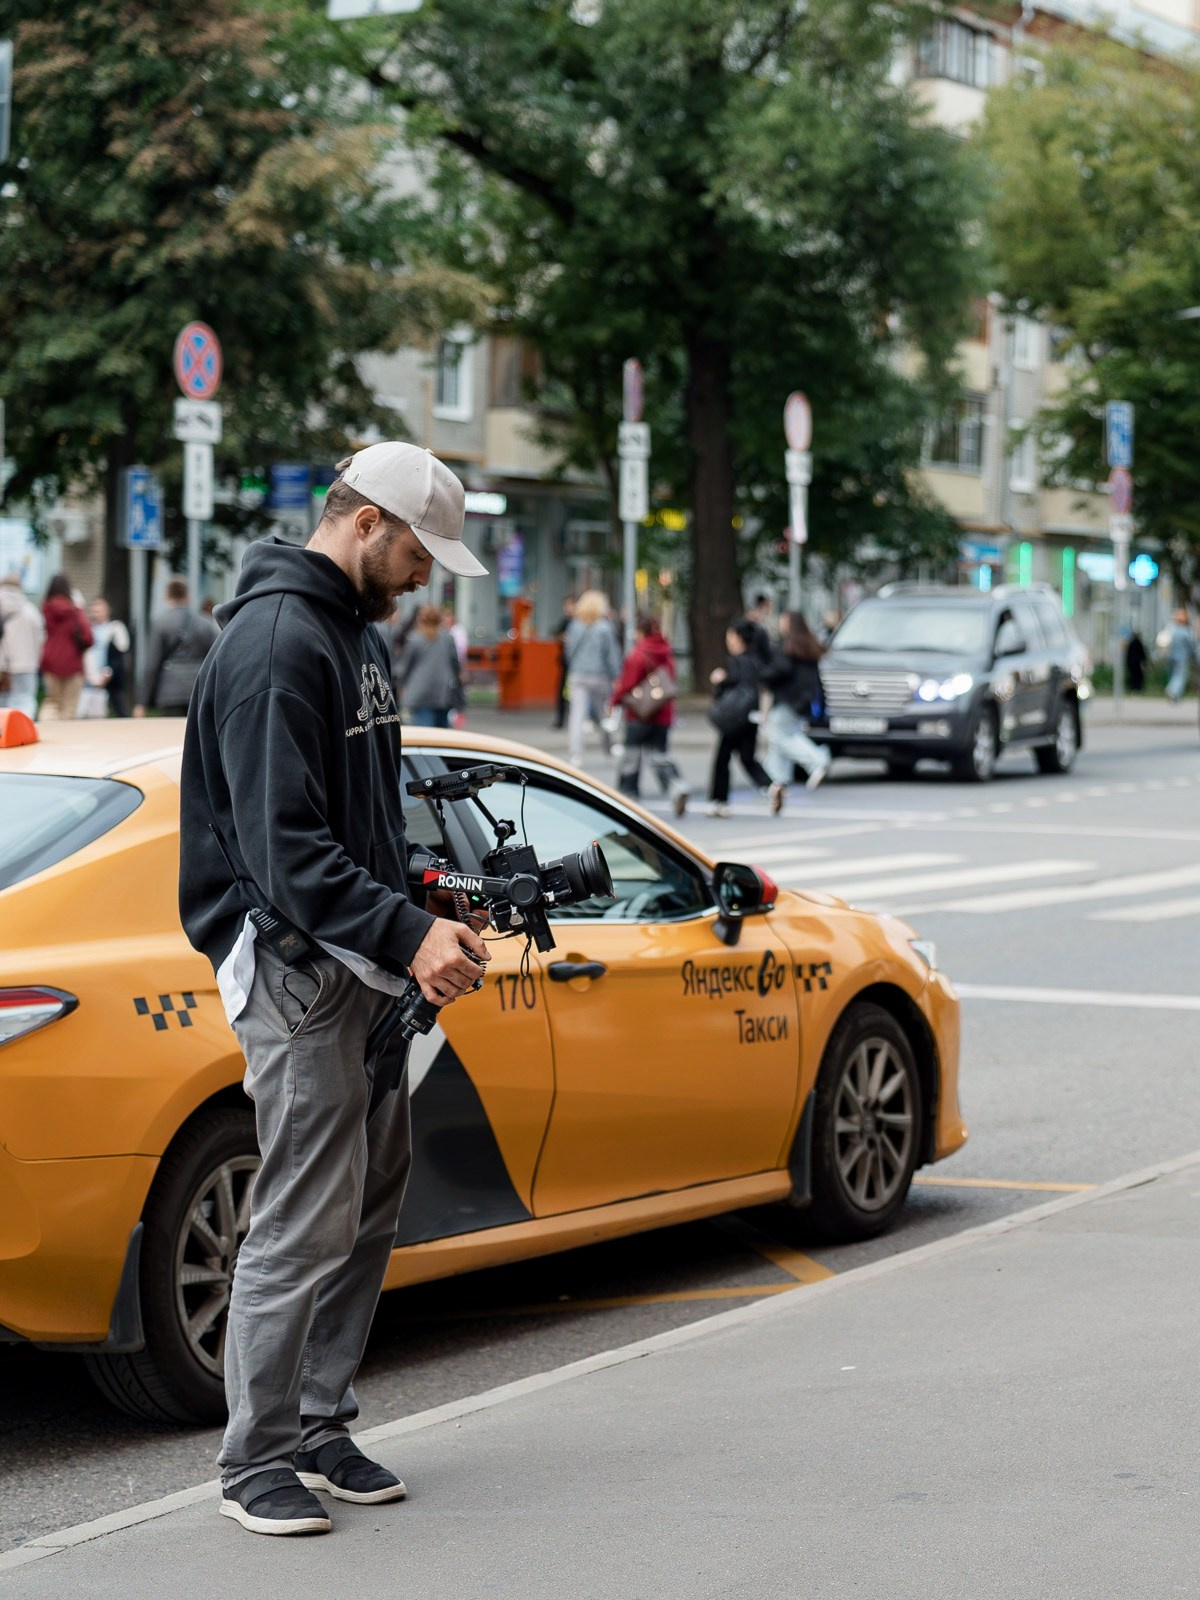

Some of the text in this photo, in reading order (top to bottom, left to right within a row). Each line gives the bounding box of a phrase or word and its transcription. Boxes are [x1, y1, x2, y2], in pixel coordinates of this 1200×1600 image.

[438, 873, 483, 891] RONIN
[494, 973, 536, 1012] 170
[681, 949, 786, 999] Яндекс Go
[734, 1008, 788, 1044] Такси
